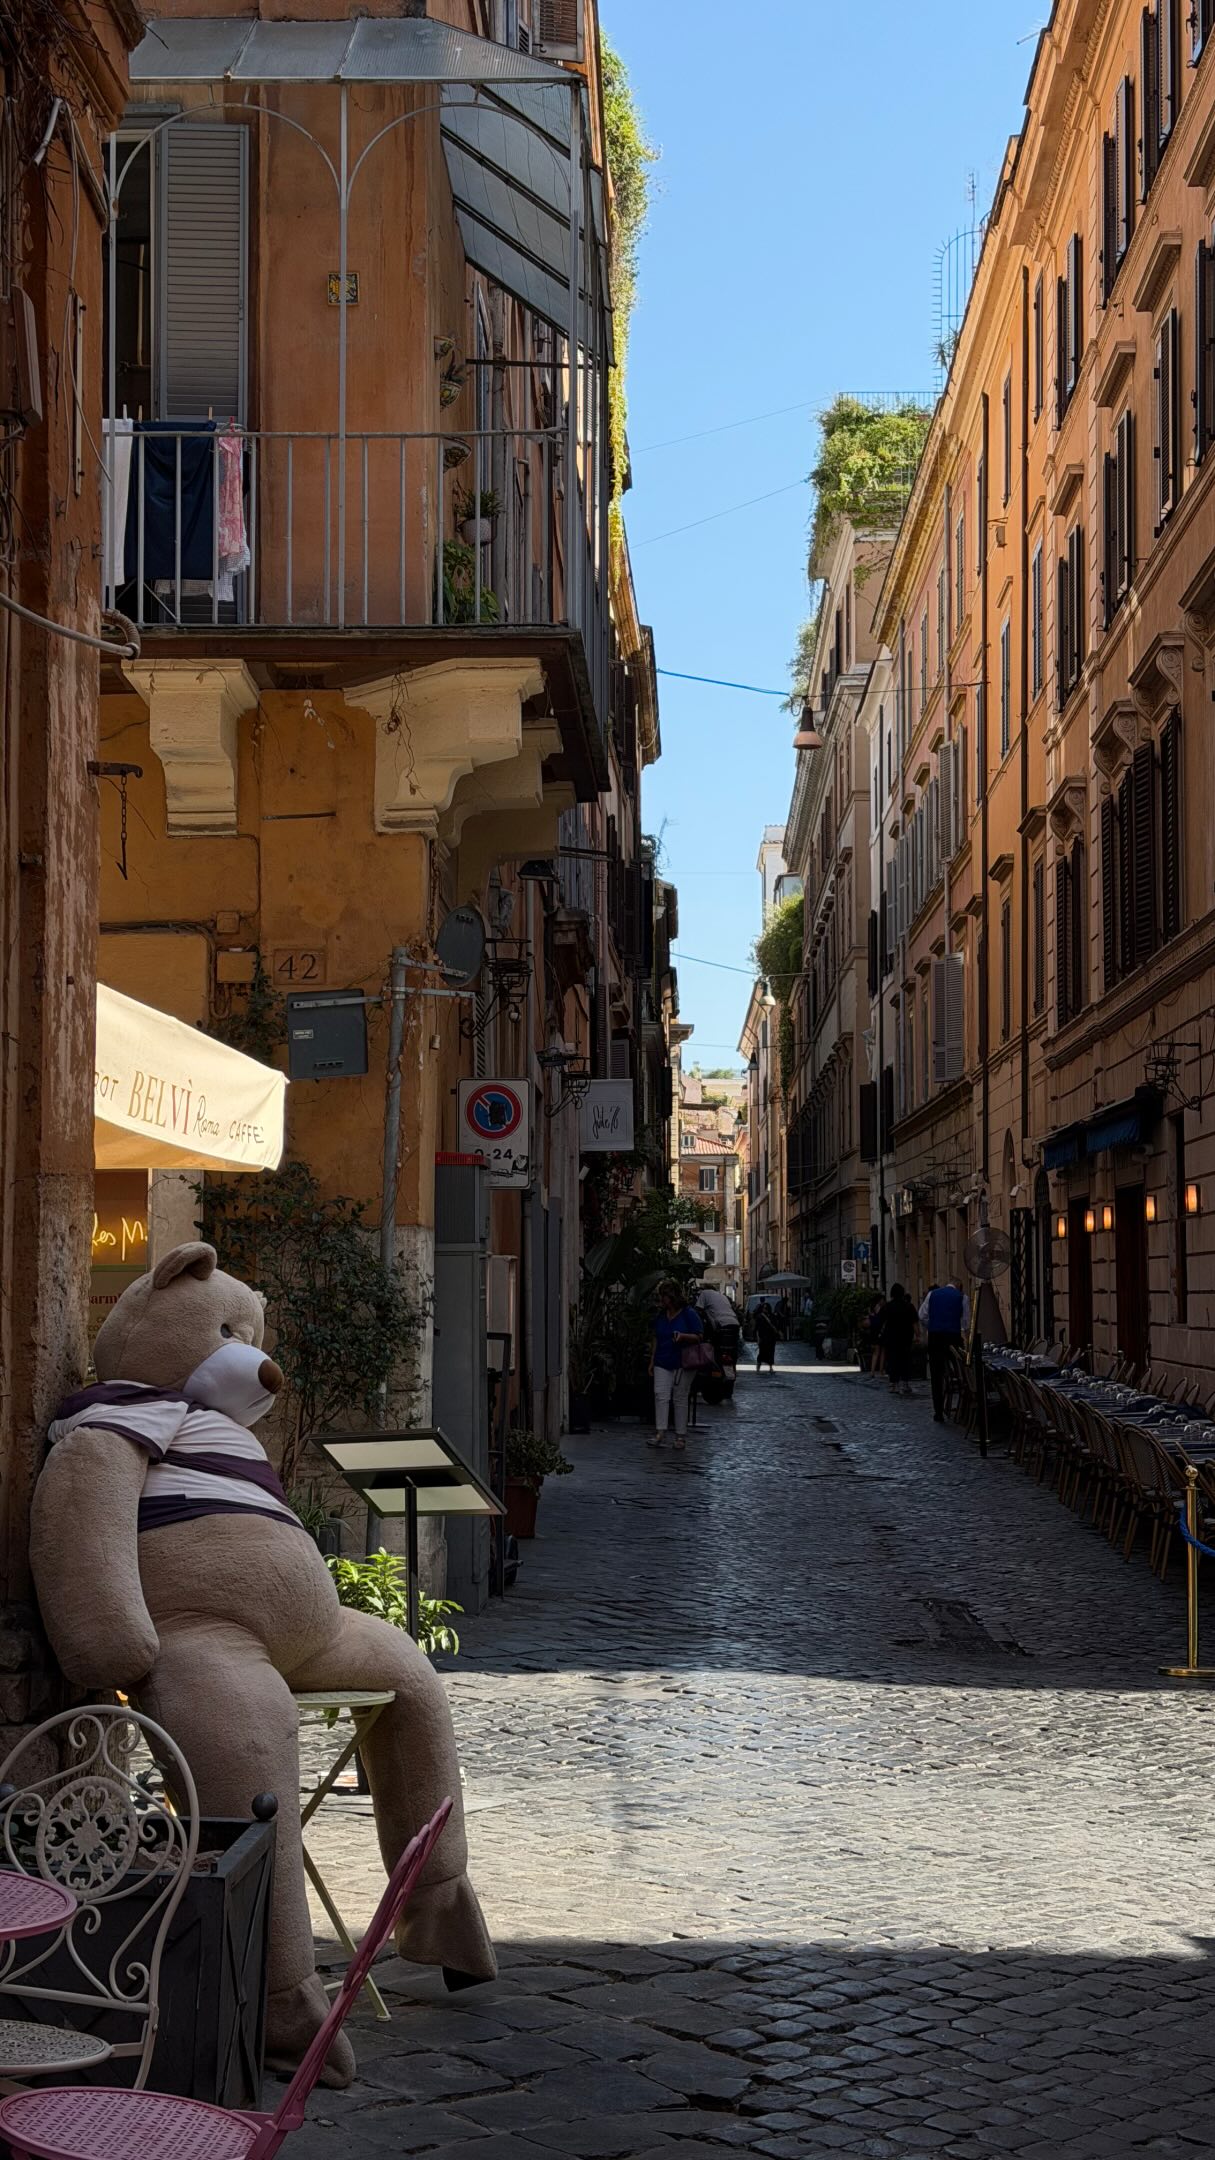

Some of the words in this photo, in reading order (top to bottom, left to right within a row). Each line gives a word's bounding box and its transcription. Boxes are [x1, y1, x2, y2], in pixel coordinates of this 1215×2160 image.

[278, 953, 318, 979] 42
[127, 1070, 192, 1135] BELVÌ
[193, 1095, 219, 1137] Roma
